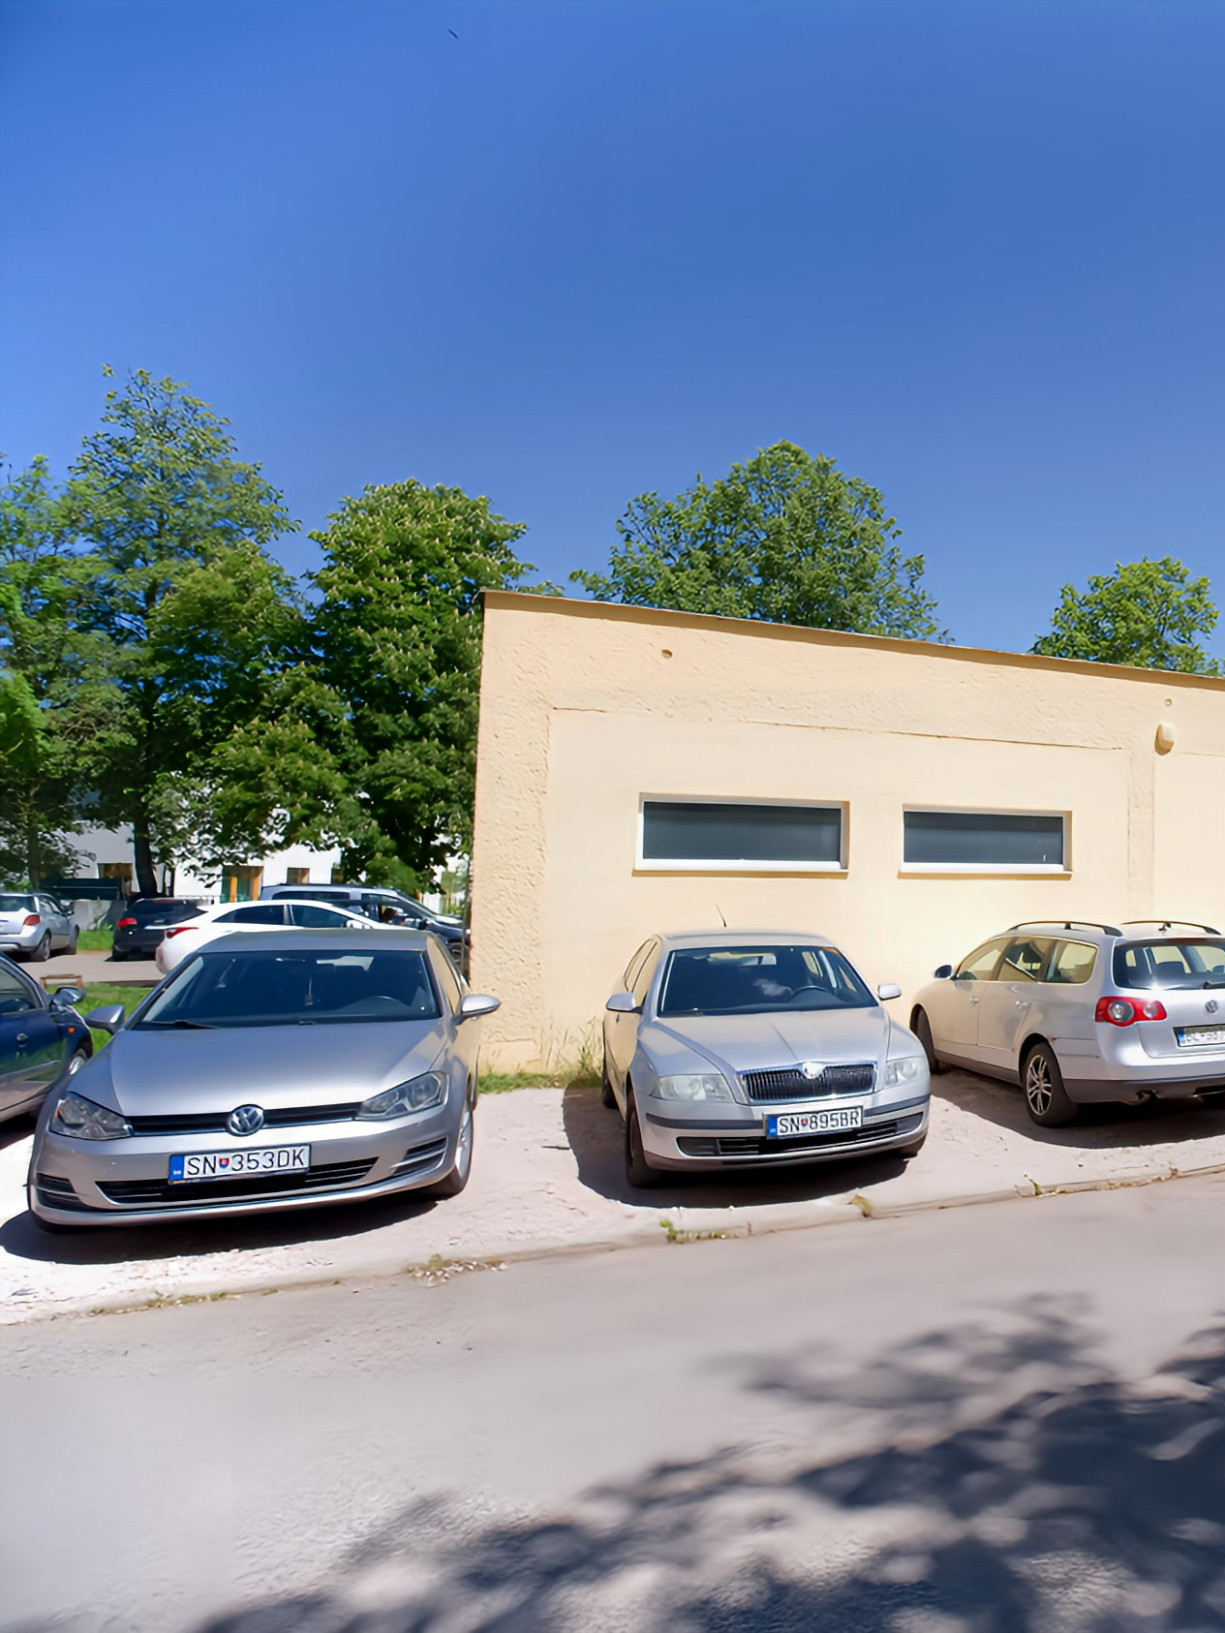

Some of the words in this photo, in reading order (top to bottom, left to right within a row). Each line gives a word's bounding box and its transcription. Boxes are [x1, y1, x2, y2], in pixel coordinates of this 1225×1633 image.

[779, 1117, 800, 1133] SN
[809, 1111, 860, 1130] 895BR
[187, 1155, 217, 1176] SN
[231, 1148, 304, 1172] 353DK
